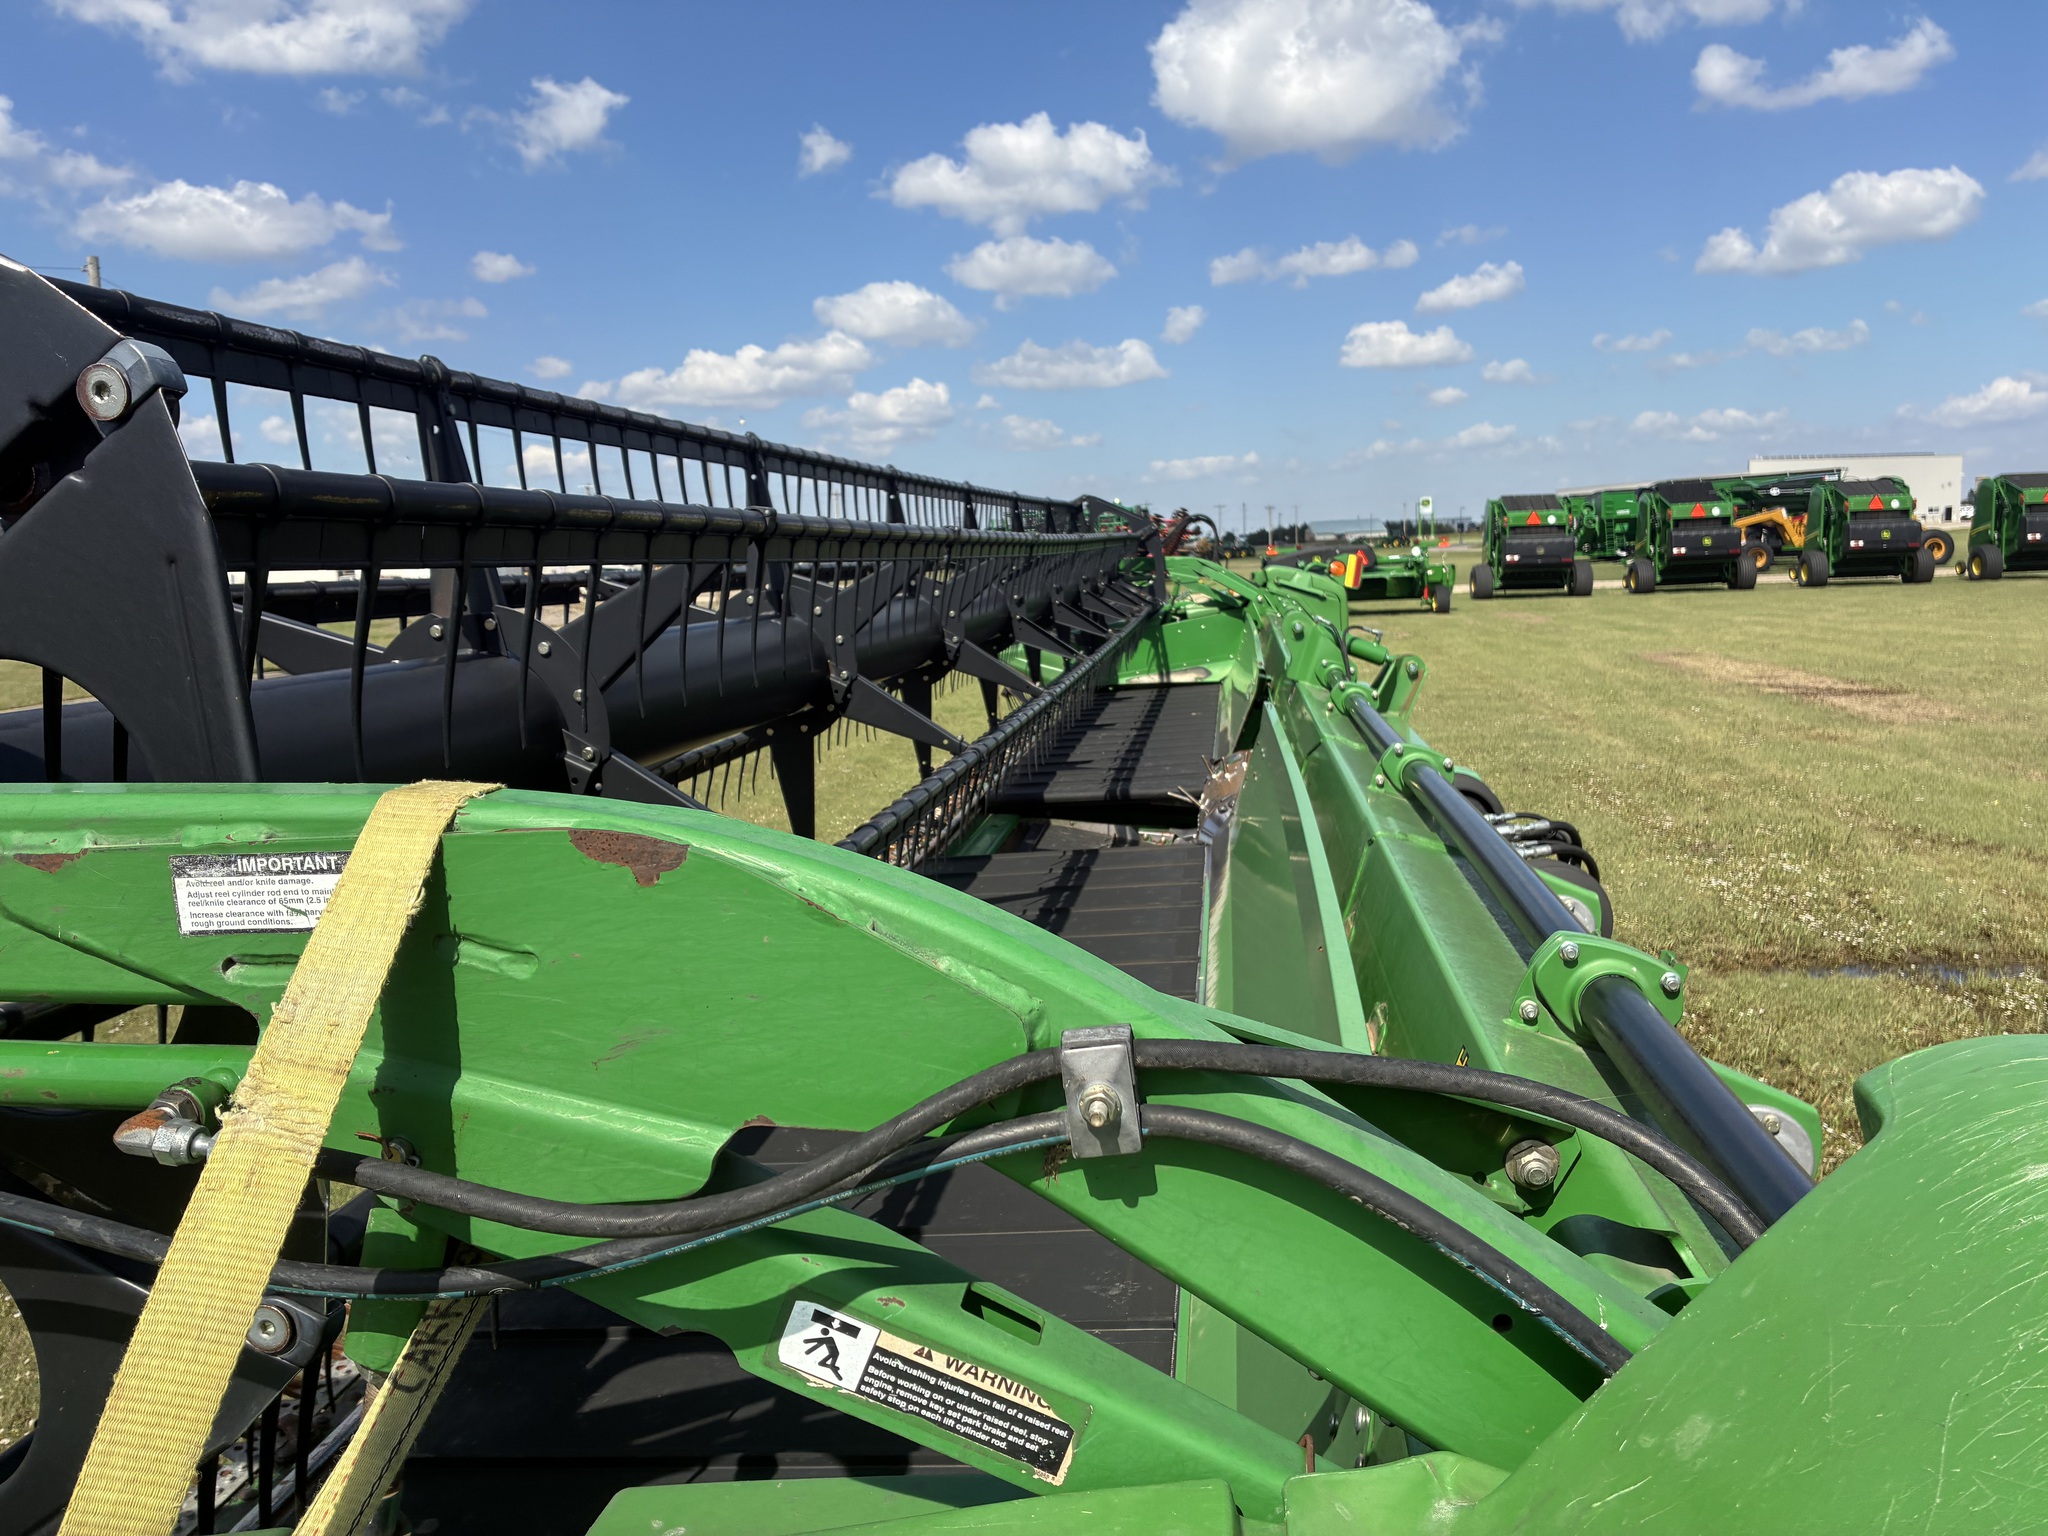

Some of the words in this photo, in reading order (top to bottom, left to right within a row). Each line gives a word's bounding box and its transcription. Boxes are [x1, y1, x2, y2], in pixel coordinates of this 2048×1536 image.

[237, 855, 338, 872] IMPORTANT
[186, 879, 208, 888] Avoid
[209, 879, 225, 887] reel
[227, 879, 253, 887] and/or
[255, 878, 275, 886] knife
[277, 878, 314, 887] damage.
[187, 890, 213, 900] Adjust
[214, 890, 230, 898] reel
[232, 889, 265, 899] cylinder
[267, 889, 281, 897] rod
[283, 888, 299, 896] end
[301, 888, 311, 896] to
[188, 900, 225, 908] reel/knife
[226, 899, 266, 907] clearance
[278, 897, 304, 905] 65mm
[306, 896, 322, 907] (2.5
[189, 911, 224, 919] Increase
[225, 909, 264, 918] clearance
[266, 909, 284, 917] with
[191, 919, 214, 928] rough
[216, 918, 245, 928] ground
[247, 917, 294, 926] conditions.
[867, 1365, 896, 1382] Before
[897, 1377, 931, 1398] working
[932, 1391, 944, 1402] on
[945, 1397, 956, 1407] or
[956, 1400, 982, 1417] under
[983, 1412, 1010, 1428] raised
[1010, 1424, 1028, 1438] reel,
[873, 1352, 897, 1368] Avoid
[899, 1363, 936, 1385] crushing
[937, 1378, 970, 1397] injuries
[971, 1391, 991, 1406] from
[992, 1400, 1006, 1413] fall
[1007, 1407, 1017, 1416] of
[1024, 1415, 1051, 1431] raised
[1051, 1426, 1069, 1439] reel.
[860, 1384, 886, 1400] safety
[887, 1394, 906, 1408] stop
[908, 1403, 919, 1413] on
[921, 1408, 941, 1422] each
[943, 1416, 955, 1428] lift
[956, 1423, 990, 1442] cylinder
[991, 1438, 1008, 1450] rod.
[863, 1375, 894, 1393] engine,
[895, 1388, 928, 1406] remove
[929, 1401, 945, 1415] key,
[946, 1408, 961, 1420] set
[962, 1415, 982, 1428] park
[983, 1422, 1007, 1438] brake
[1007, 1434, 1024, 1446] and
[1025, 1441, 1039, 1452] set
